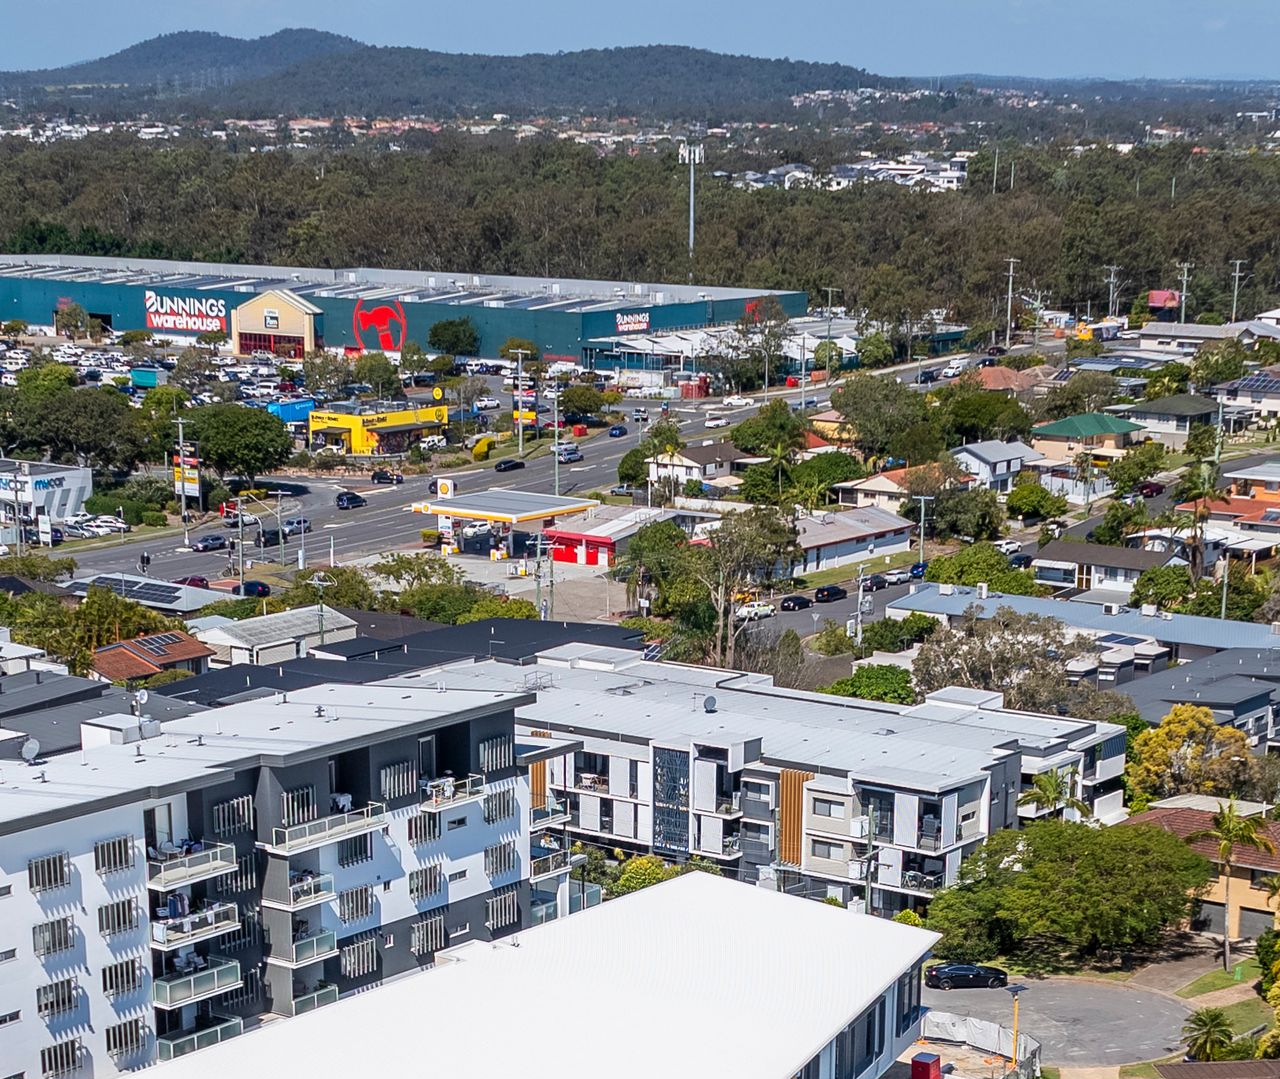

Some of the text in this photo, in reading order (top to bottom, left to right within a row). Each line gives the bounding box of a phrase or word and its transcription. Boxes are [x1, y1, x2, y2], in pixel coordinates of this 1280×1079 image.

[144, 290, 226, 318] BUNNINGS
[150, 313, 221, 332] warehouse
[616, 312, 650, 325] BUNNINGS
[34, 476, 66, 491] mycar
